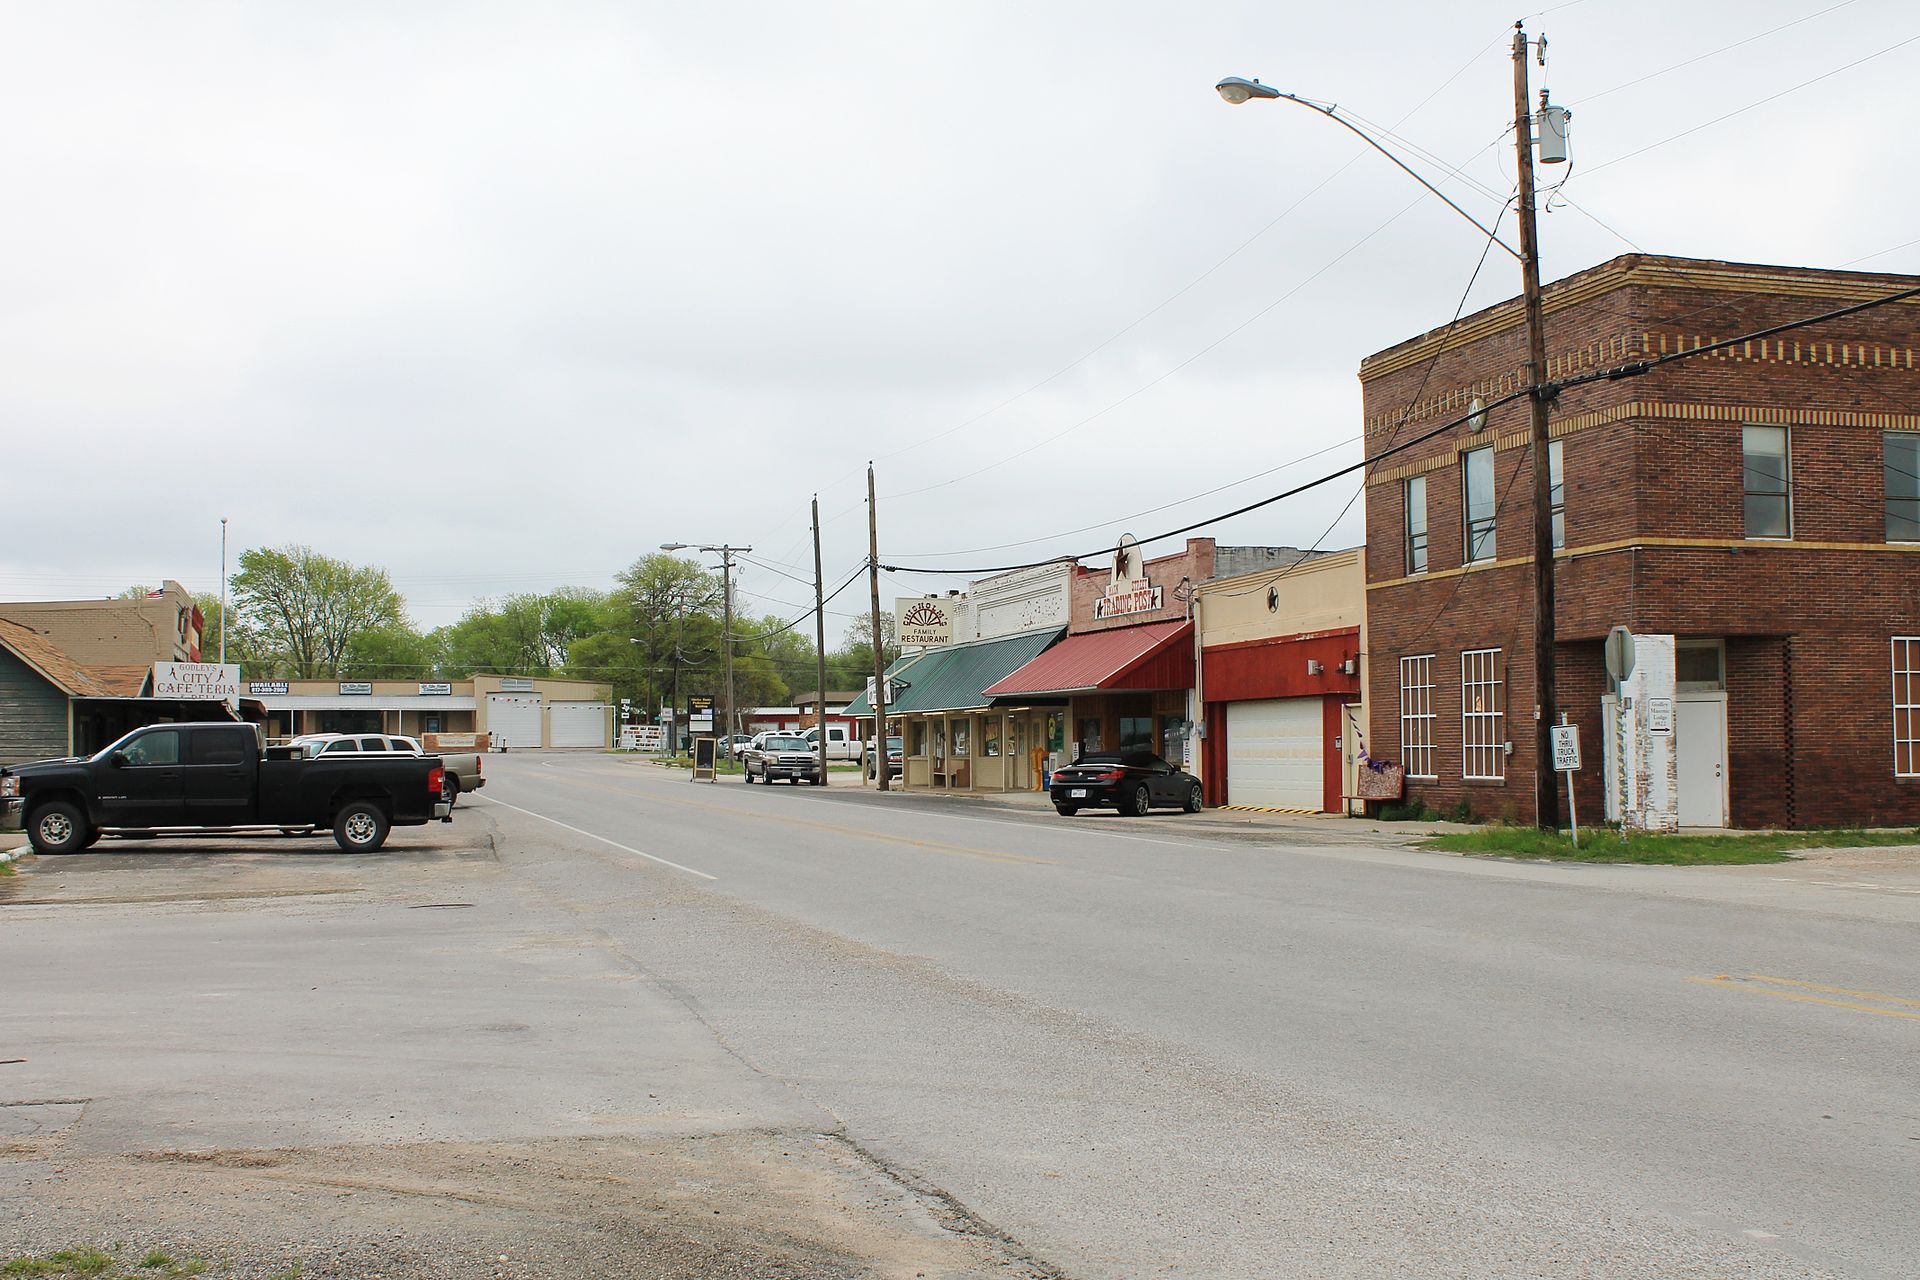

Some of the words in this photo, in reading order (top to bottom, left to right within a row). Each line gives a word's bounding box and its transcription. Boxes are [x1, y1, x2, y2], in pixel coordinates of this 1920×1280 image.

[1131, 579, 1148, 592] STREET
[1103, 594, 1132, 617] TRADING
[1133, 590, 1152, 612] POST
[903, 602, 948, 627] CHISHOLM'S
[901, 635, 949, 643] RESTAURANT
[179, 664, 217, 672] GODLEY'S
[182, 673, 213, 683] CITY
[157, 683, 235, 694] CAFE'TERIA
[1560, 730, 1569, 739] NO
[1558, 740, 1573, 748] THRU
[1556, 747, 1575, 755] TRUCK
[1556, 755, 1578, 764] TRAFFIC
